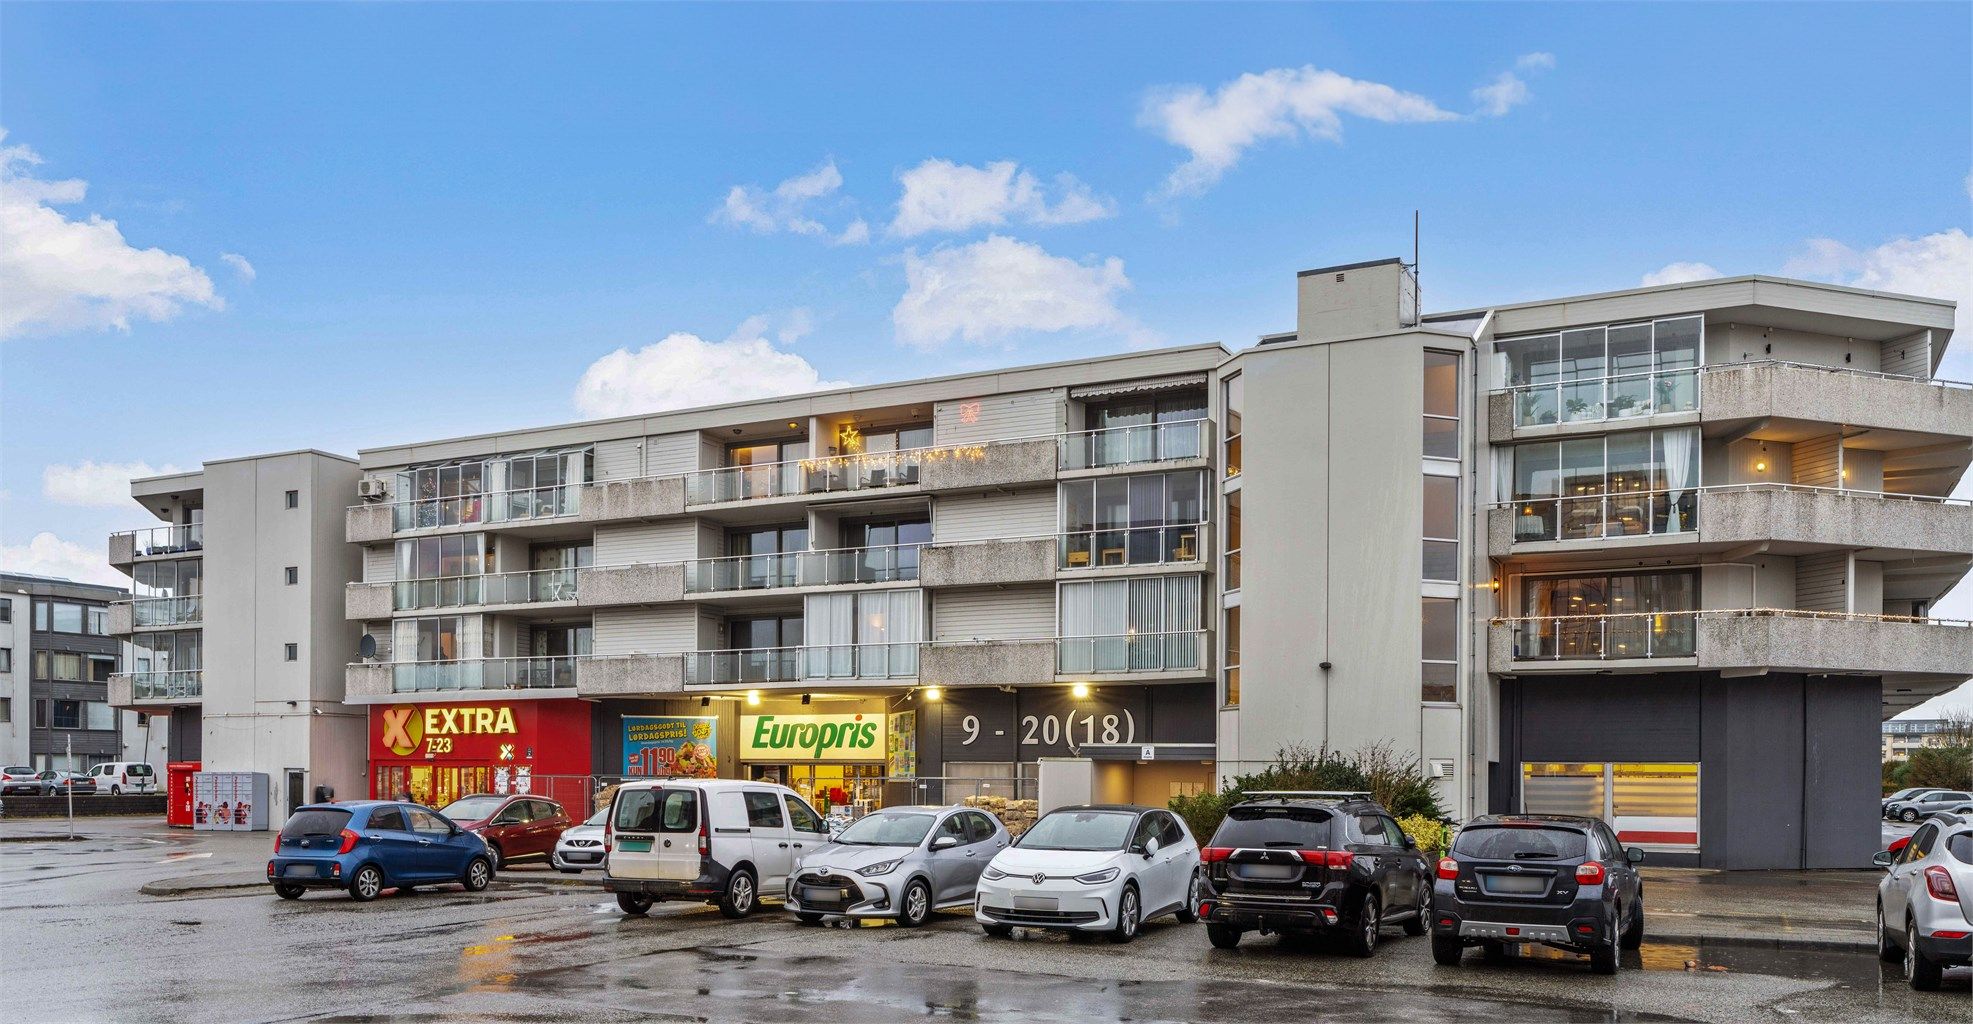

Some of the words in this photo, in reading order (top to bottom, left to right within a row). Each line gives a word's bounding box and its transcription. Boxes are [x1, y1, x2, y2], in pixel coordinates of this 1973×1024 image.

[424, 707, 517, 735] EXTRA
[677, 721, 687, 729] TIL
[962, 715, 981, 746] 9
[1022, 709, 1135, 747] 20(18)
[426, 738, 453, 753] 7-23
[628, 729, 687, 741] LØRDAGSPRIS!
[751, 714, 878, 759] Europris
